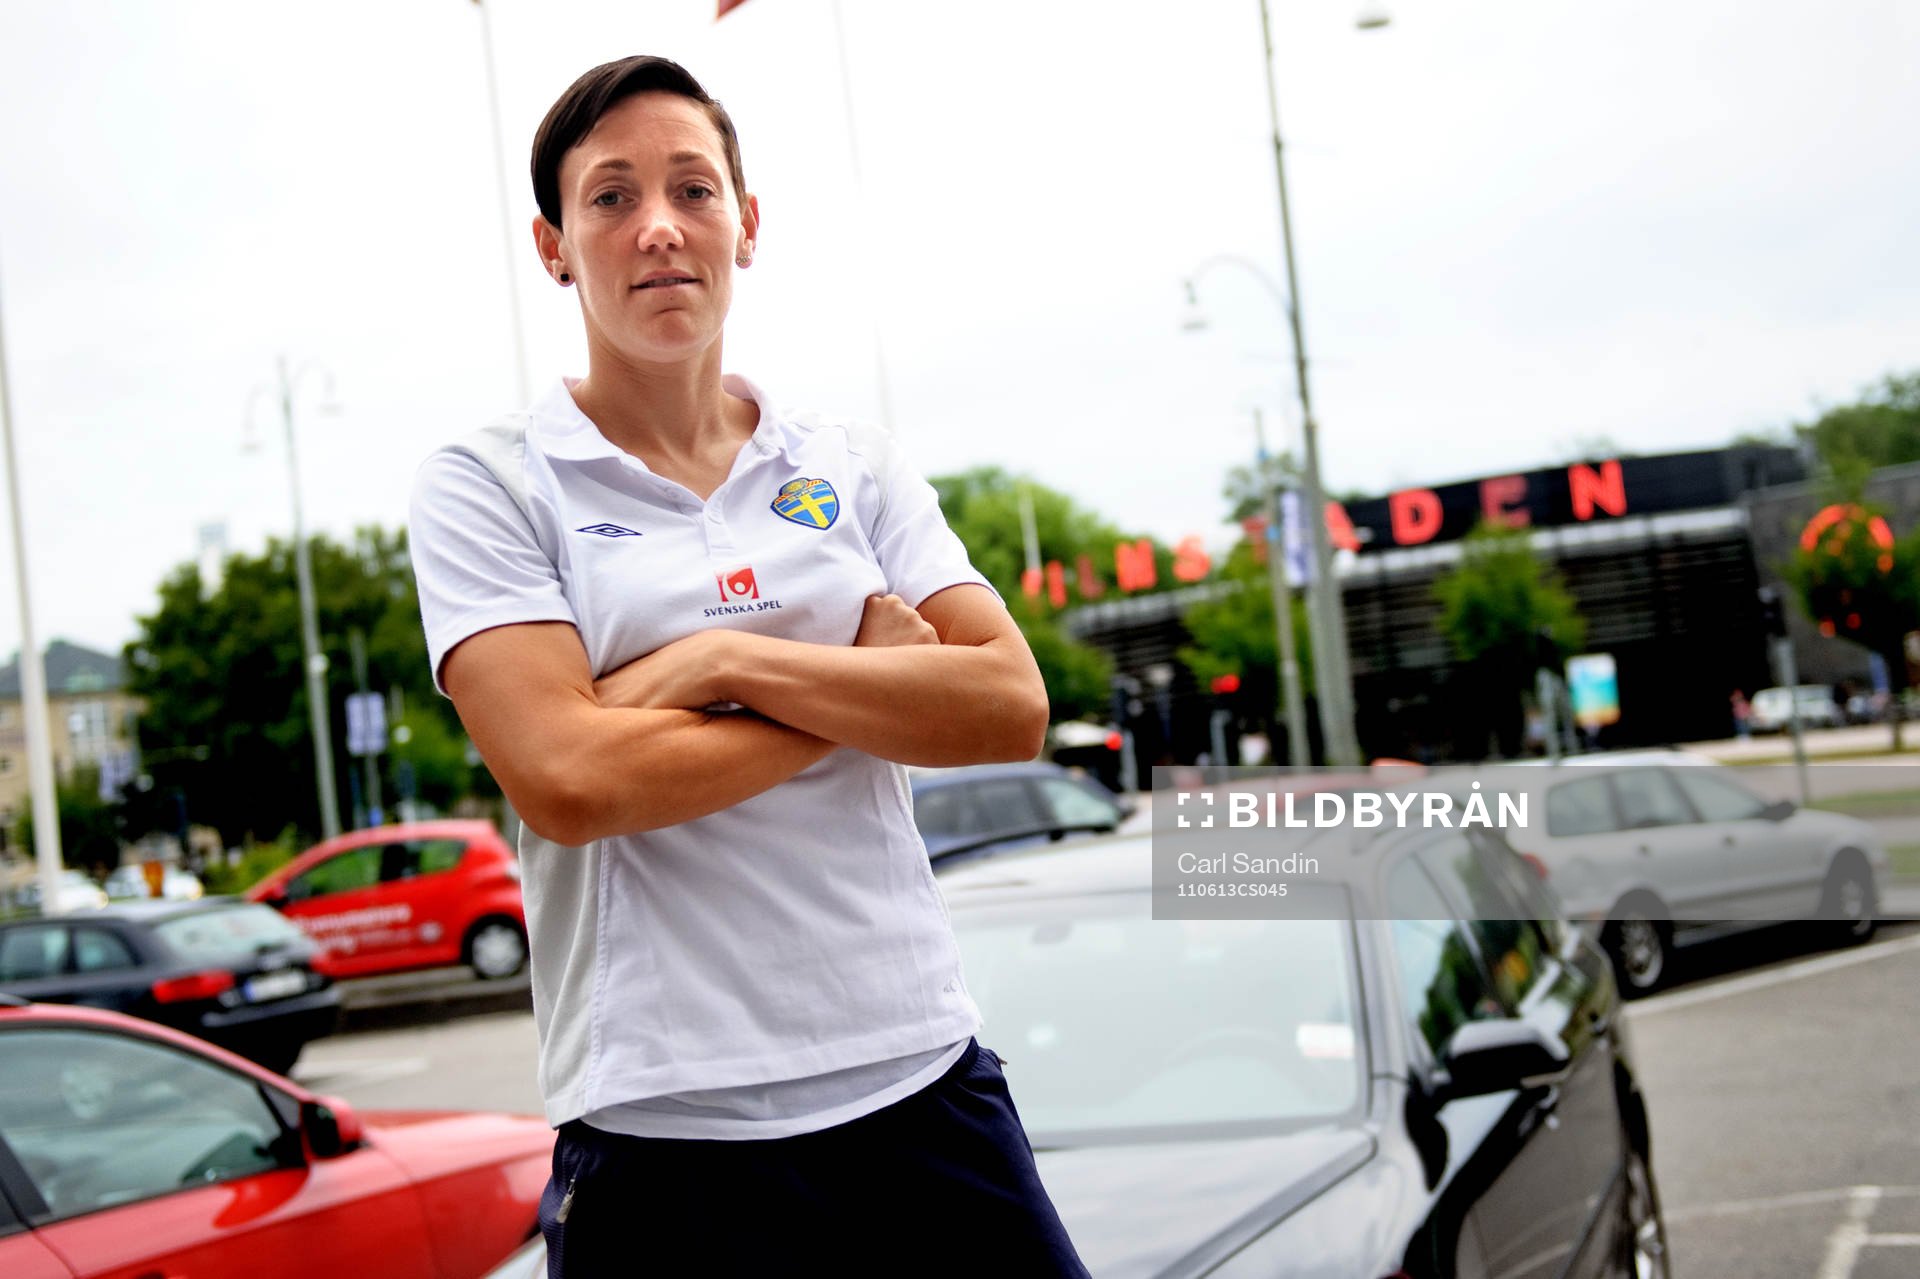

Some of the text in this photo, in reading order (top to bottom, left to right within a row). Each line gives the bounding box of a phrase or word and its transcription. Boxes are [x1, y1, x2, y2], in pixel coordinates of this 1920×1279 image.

[1021, 459, 1627, 613] ILMSTDEN
[704, 600, 782, 617] SVENSKA SPEL
